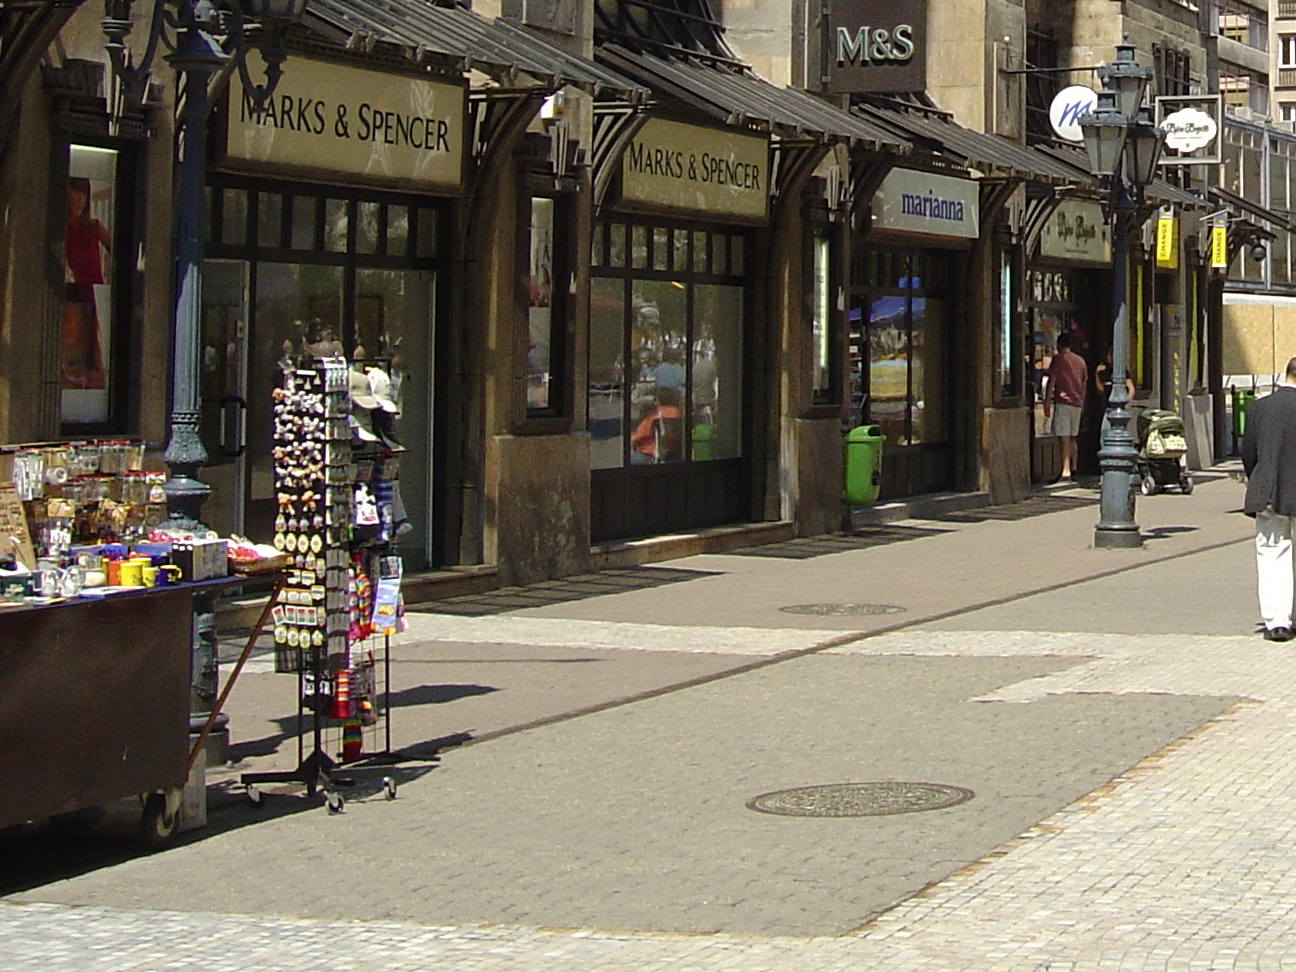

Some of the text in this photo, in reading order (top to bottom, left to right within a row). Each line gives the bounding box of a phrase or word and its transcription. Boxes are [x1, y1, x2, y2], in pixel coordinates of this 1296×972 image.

[836, 24, 914, 62] M&S
[241, 90, 450, 153] MARKS & SPENCER
[629, 140, 761, 191] MARKS & SPENCER
[901, 190, 964, 222] marianna
[1160, 222, 1169, 258] CHANGE
[1214, 230, 1223, 263] CHANGE
